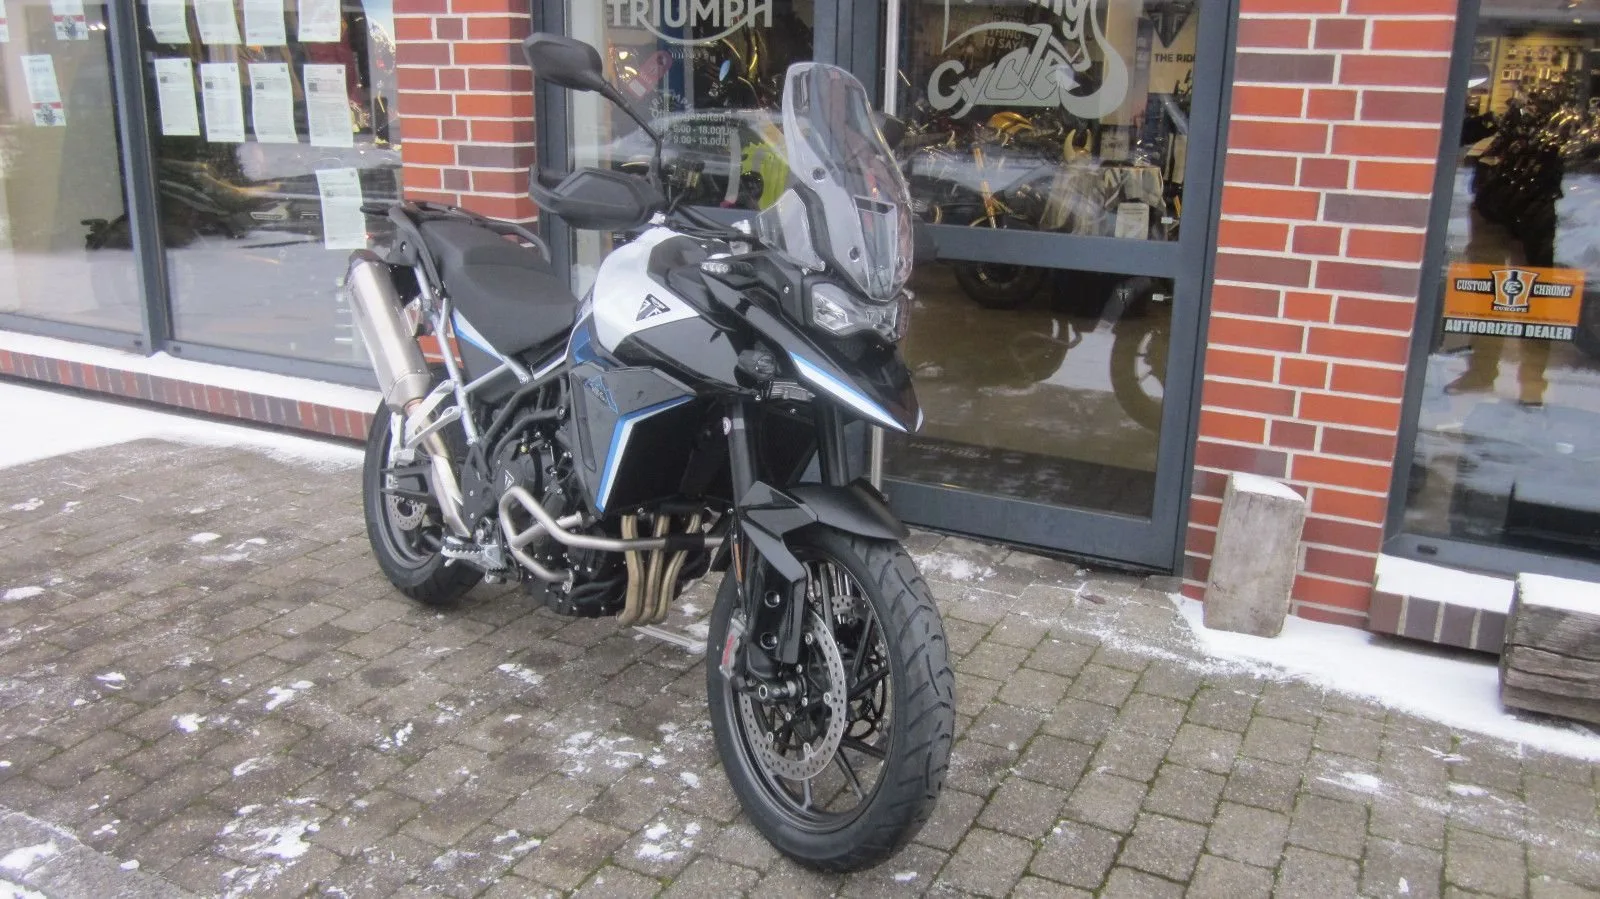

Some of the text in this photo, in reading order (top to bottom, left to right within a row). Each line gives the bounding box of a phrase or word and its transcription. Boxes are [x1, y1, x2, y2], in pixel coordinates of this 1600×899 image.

[607, 0, 773, 28] TRIUMPH
[1154, 53, 1173, 63] THE
[1456, 279, 1491, 292] CUSTOM
[1533, 284, 1572, 297] CHROME
[1444, 319, 1573, 341] AUTHORIZED DEALER
